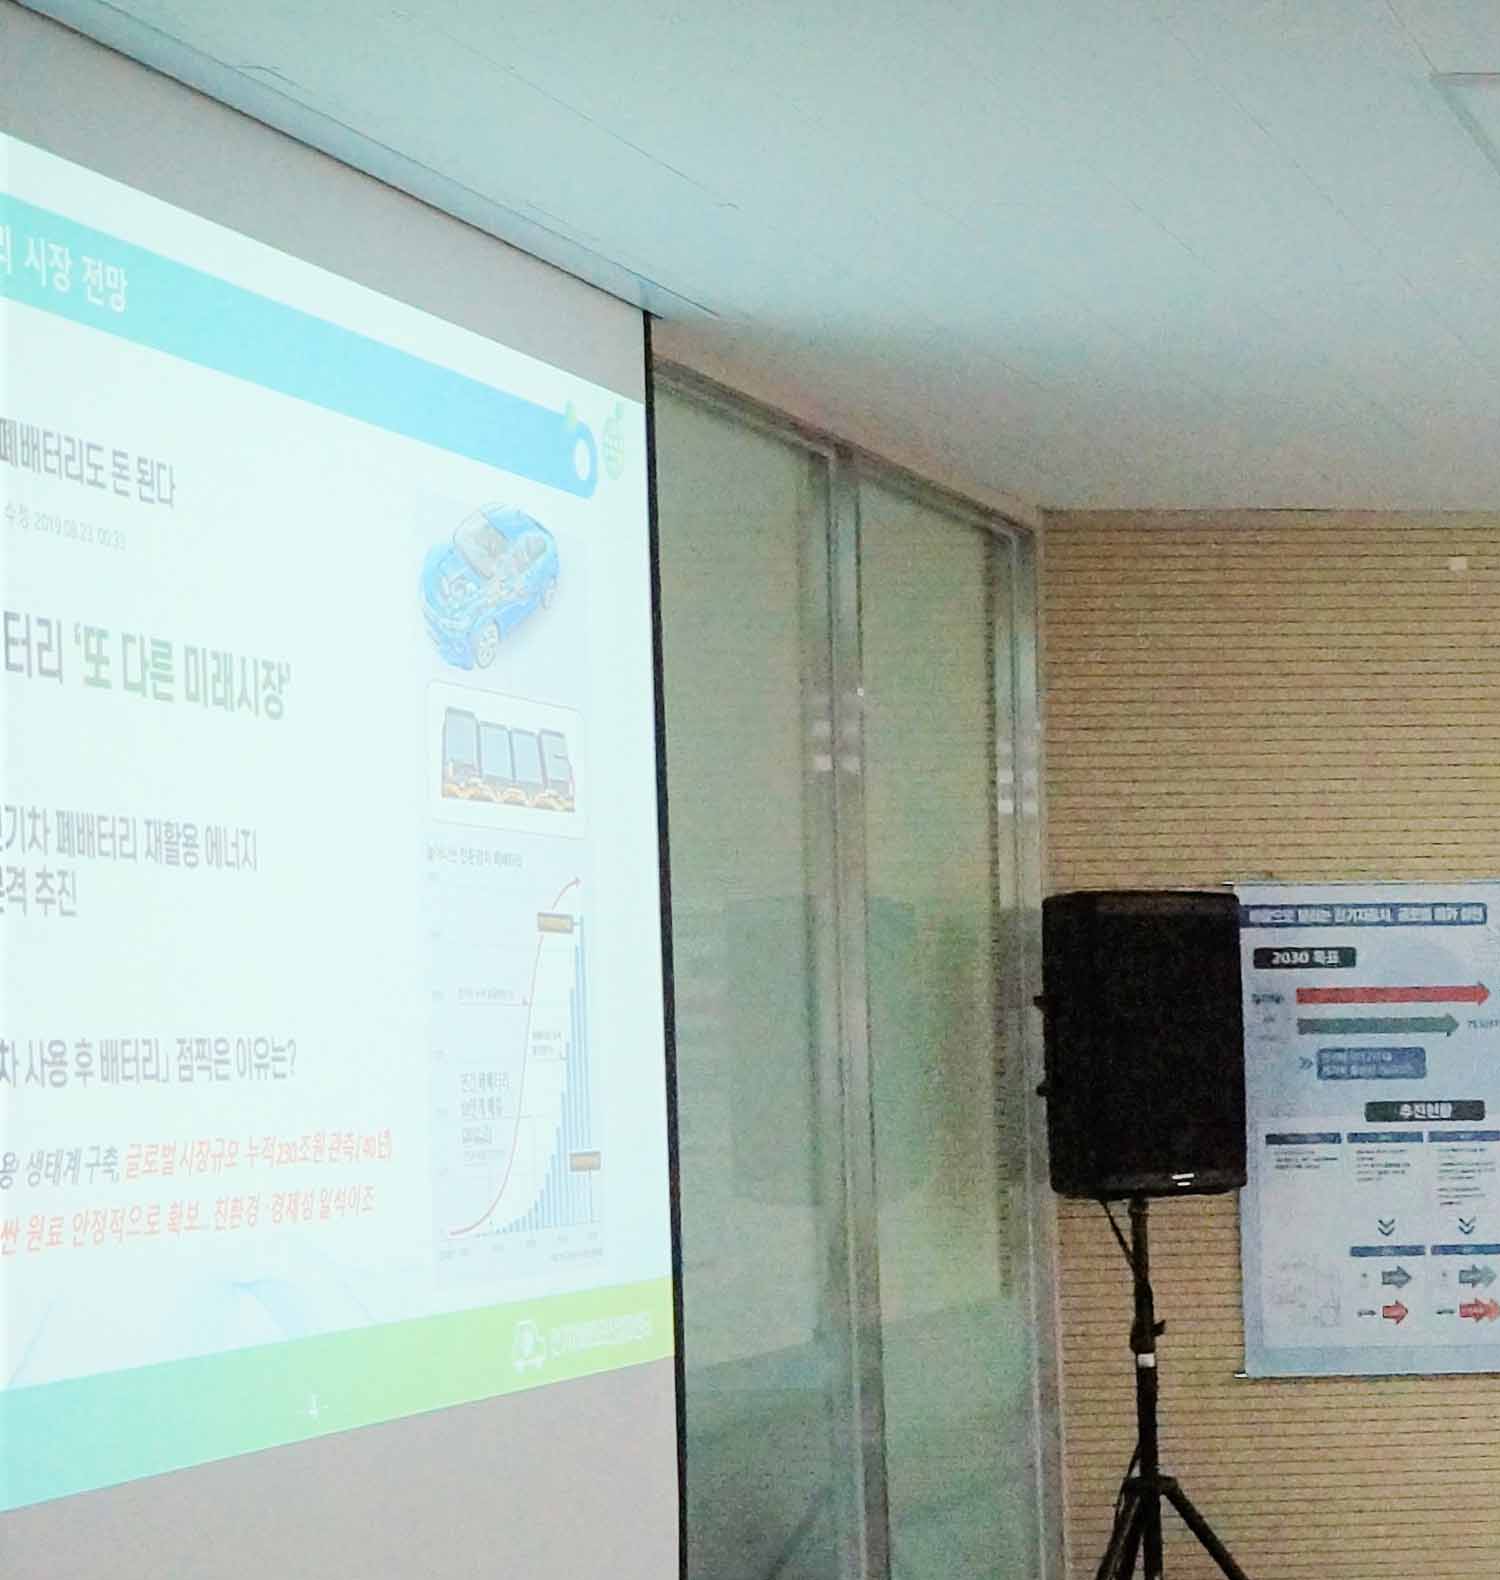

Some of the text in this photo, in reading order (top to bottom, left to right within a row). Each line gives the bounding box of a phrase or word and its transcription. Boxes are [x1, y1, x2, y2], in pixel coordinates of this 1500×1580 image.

[24, 234, 73, 293] 시장
[81, 254, 129, 313] 전망
[136, 455, 177, 509] 된다
[121, 631, 175, 703] 다른
[205, 825, 259, 873] 에너지
[35, 864, 77, 918] 추진
[24, 1038, 69, 1089] 사용
[74, 1037, 95, 1089] 후
